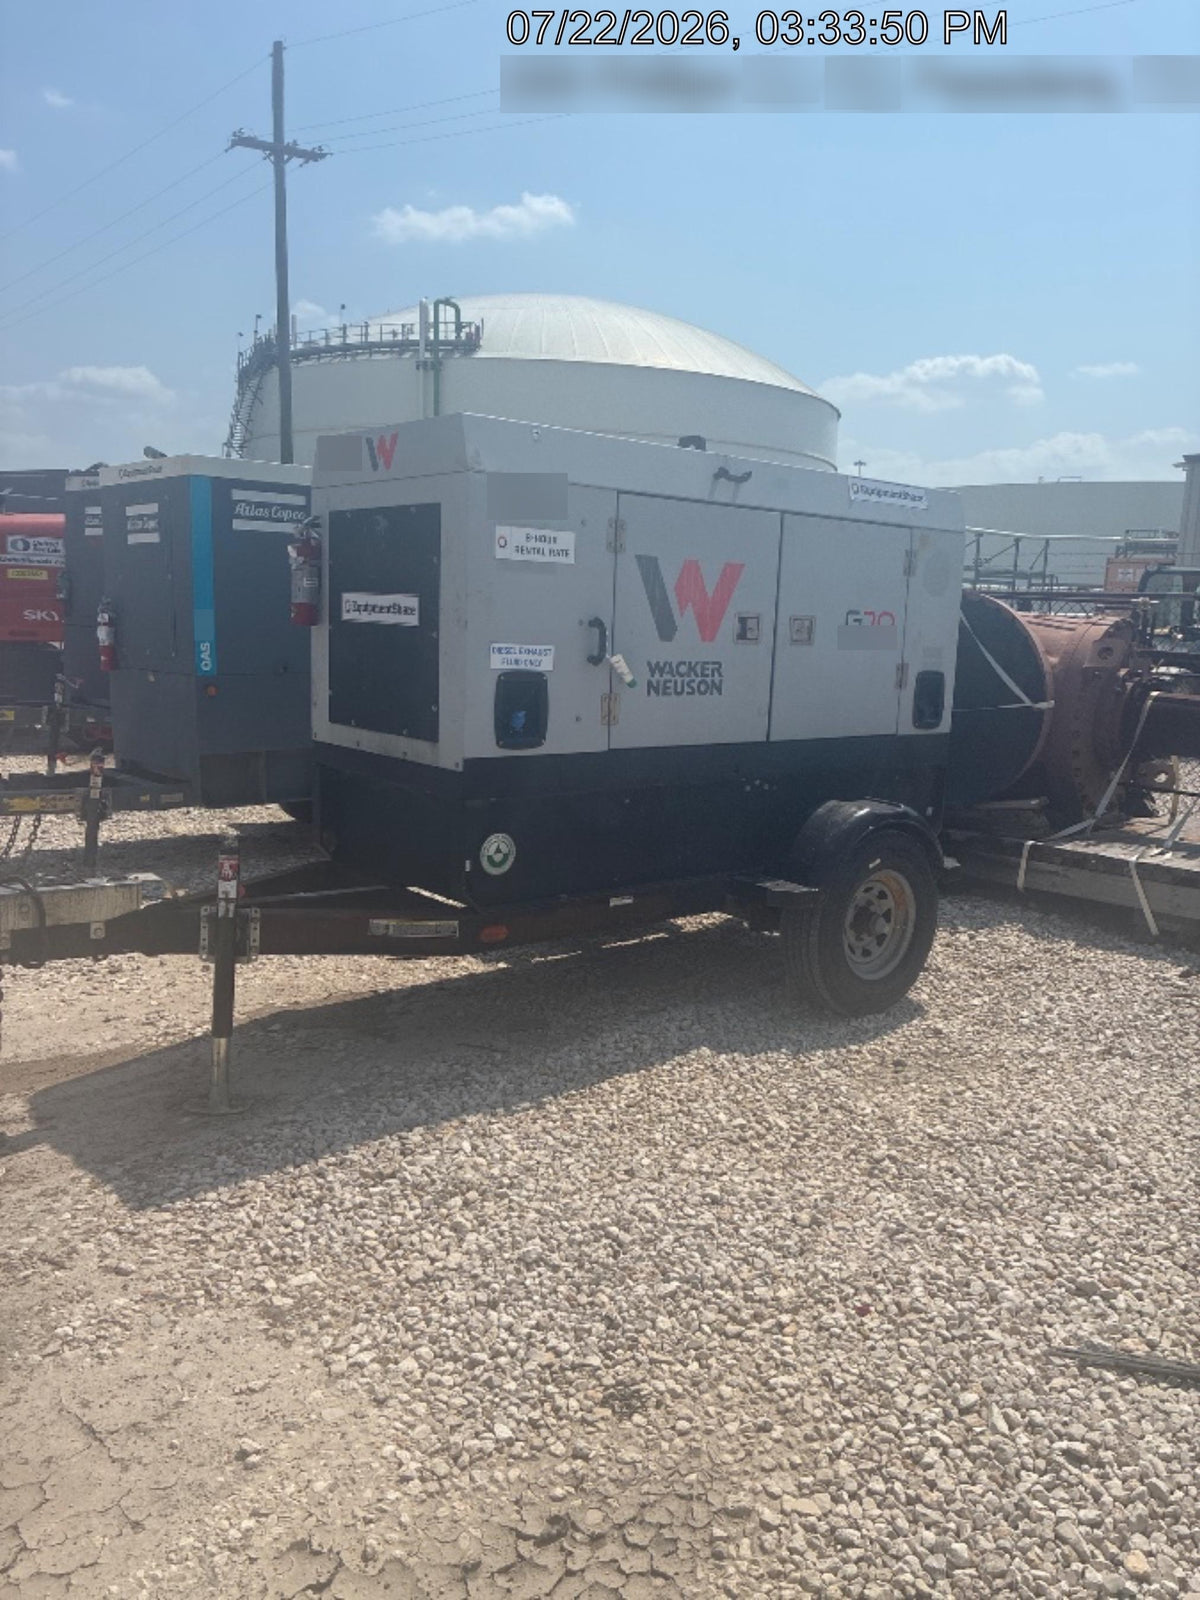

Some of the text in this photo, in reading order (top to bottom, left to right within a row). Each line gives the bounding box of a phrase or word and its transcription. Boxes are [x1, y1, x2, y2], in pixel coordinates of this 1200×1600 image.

[233, 503, 305, 521] Atlas Copco
[200, 642, 212, 671] QAS
[646, 660, 724, 679] WACKER
[646, 678, 723, 697] NEUSON
